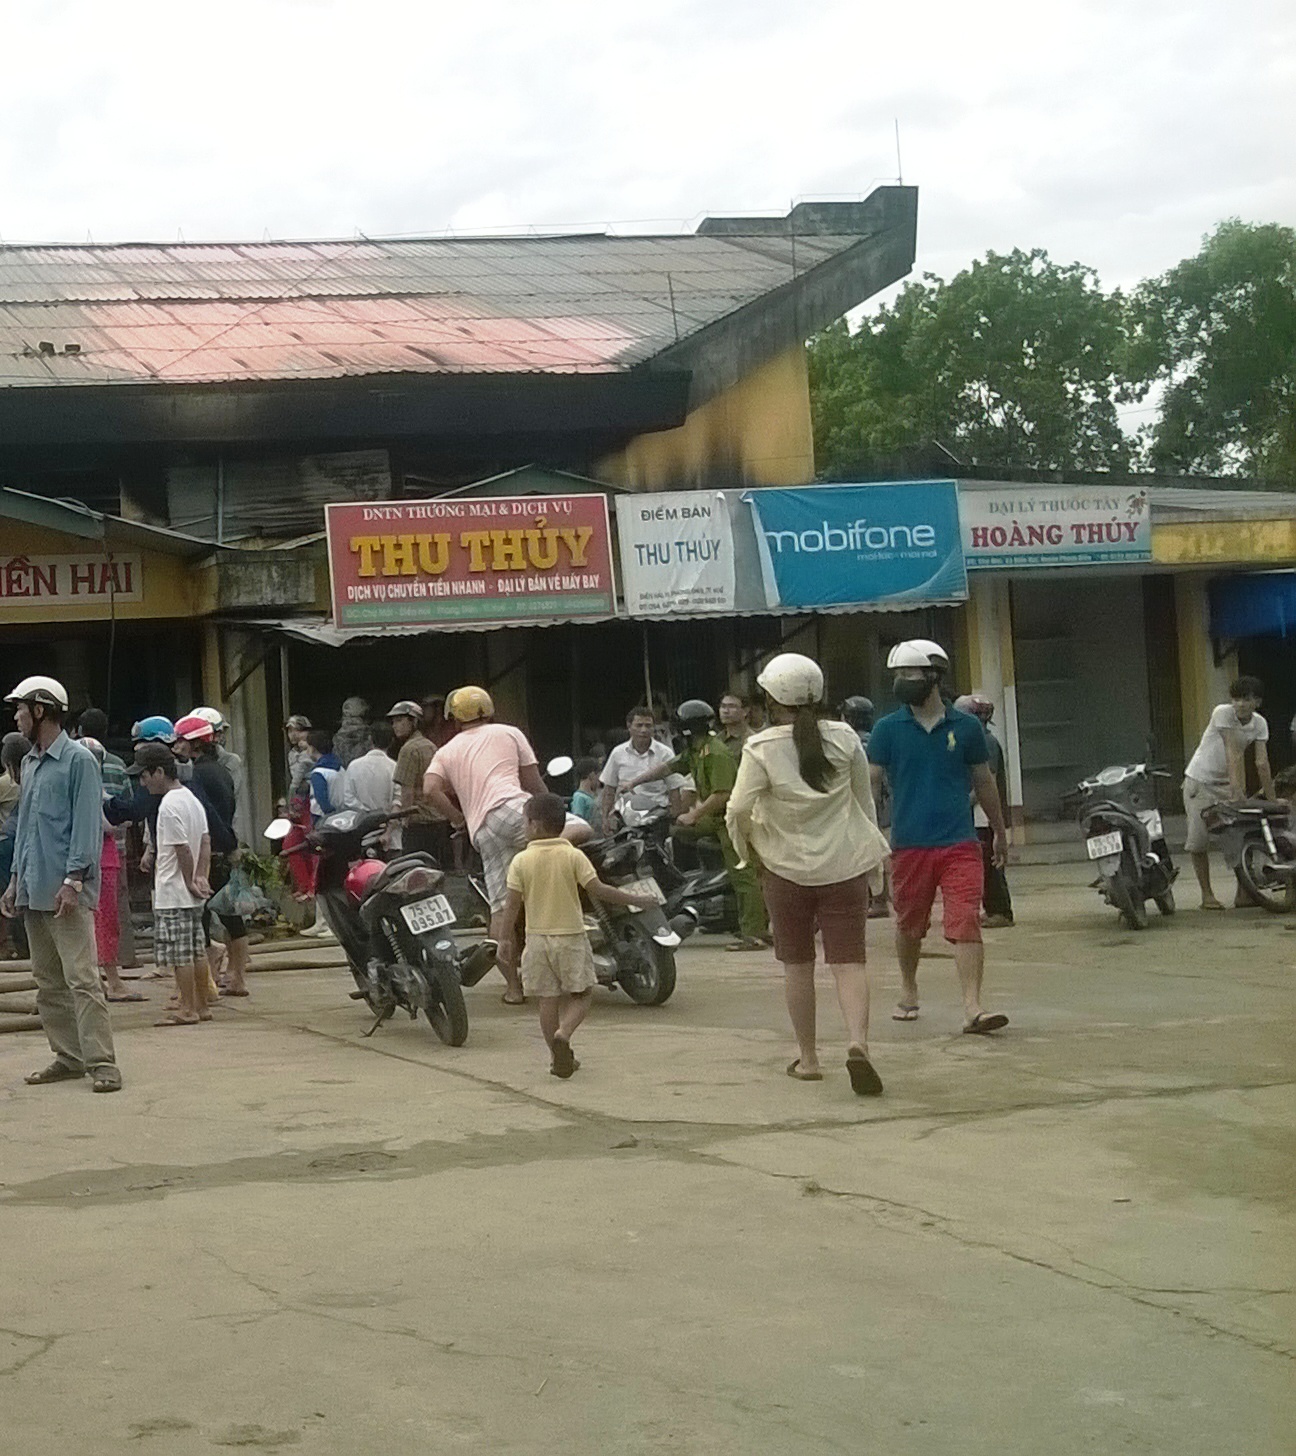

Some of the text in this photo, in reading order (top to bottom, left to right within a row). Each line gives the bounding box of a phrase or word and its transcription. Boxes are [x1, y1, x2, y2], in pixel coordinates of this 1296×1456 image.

[363, 500, 573, 520] DNTN THƯƠNG MẠI & DỊCH VỤ
[641, 505, 678, 521] ĐIỂM
[989, 501, 1013, 516] ĐẠI
[1014, 498, 1035, 513] LÝ
[764, 518, 936, 553] mobifone
[971, 516, 1139, 548] HOÀNG THÚY
[349, 516, 593, 578] THU THỦY
[634, 542, 671, 566] THU
[347, 584, 371, 602] DỊCH
[372, 584, 386, 602] VỤ
[387, 576, 427, 599] CHUYỂN
[428, 577, 451, 596] TIỀN
[451, 580, 486, 595] NHANH
[498, 578, 514, 597] ĐẠI
[515, 575, 526, 592] LÝ
[528, 574, 547, 591] BÁN
[562, 572, 581, 590] MÁY
[582, 574, 600, 588] BAY
